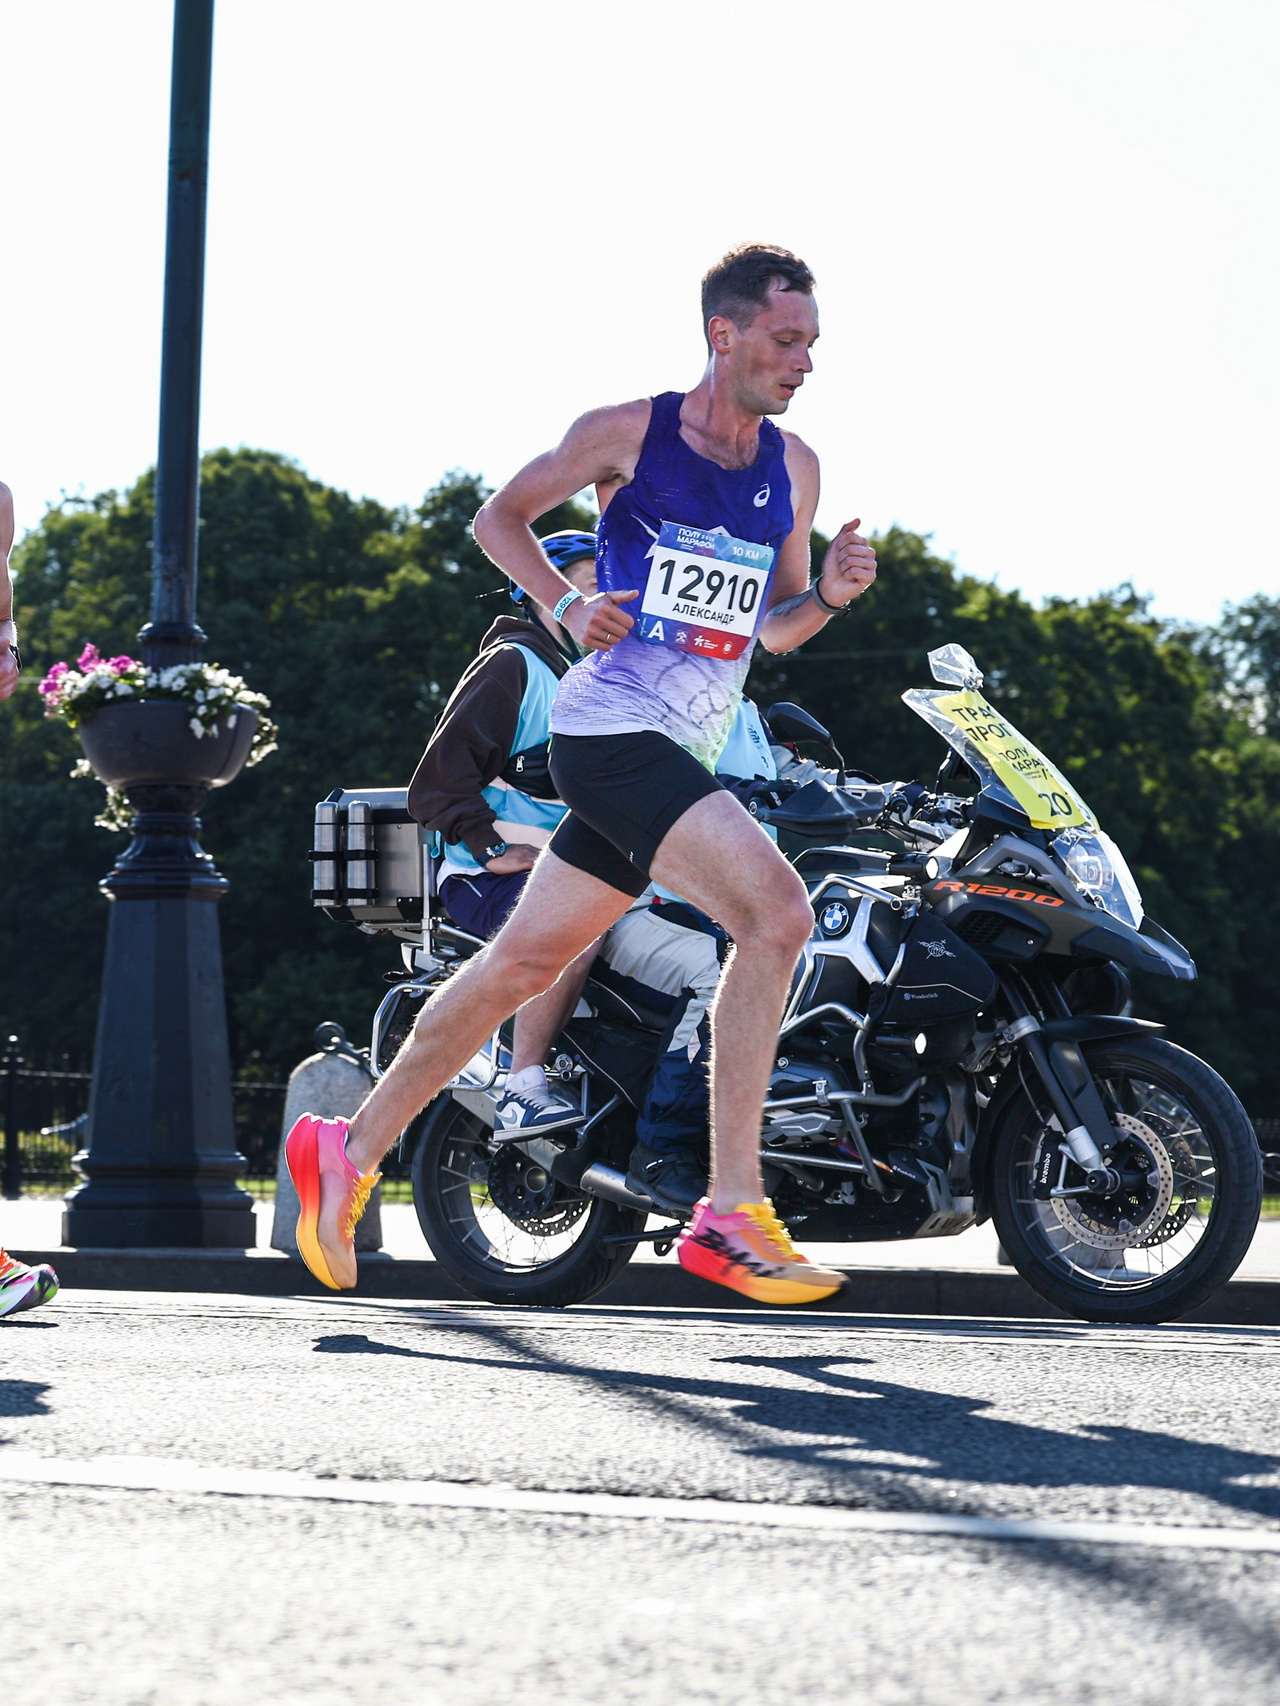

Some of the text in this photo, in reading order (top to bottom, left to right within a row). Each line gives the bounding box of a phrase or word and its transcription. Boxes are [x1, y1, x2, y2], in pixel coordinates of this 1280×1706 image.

[676, 536, 715, 550] МАРАФОН
[678, 528, 702, 539] ПОЛУ
[732, 546, 744, 556] 10
[659, 559, 759, 614] 12910
[554, 596, 572, 618] 12910
[672, 602, 735, 625] АЛЕКСАНДР
[951, 705, 996, 722] ТРА
[933, 880, 1065, 907] R1200
[1040, 1152, 1051, 1184] brembo
